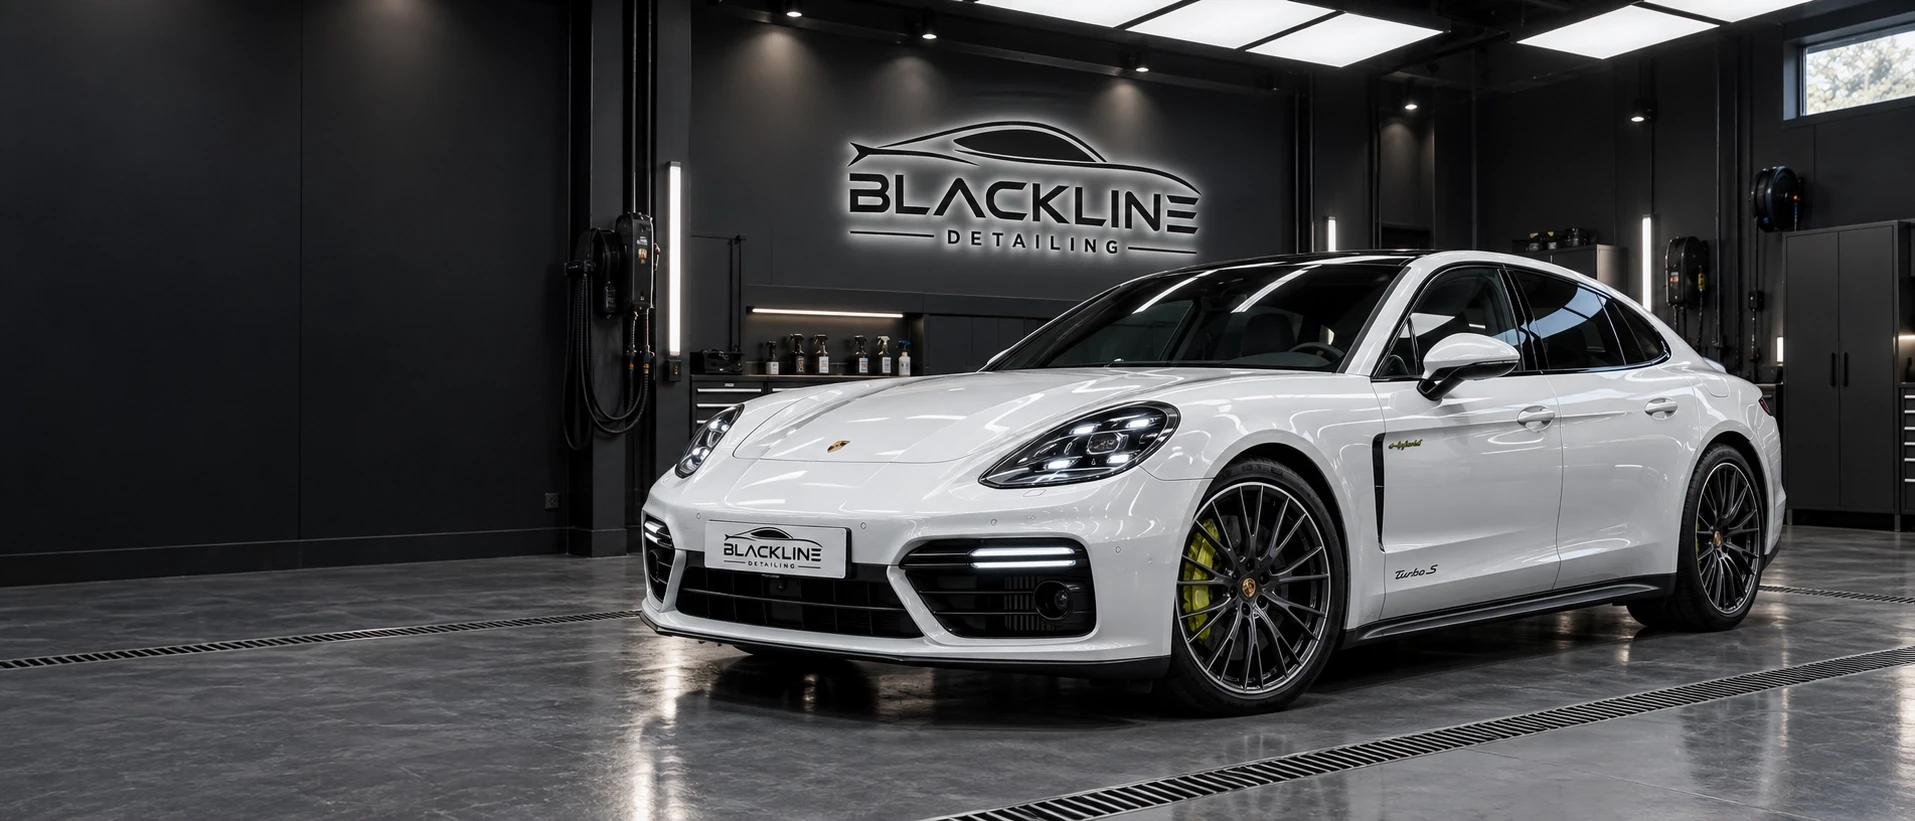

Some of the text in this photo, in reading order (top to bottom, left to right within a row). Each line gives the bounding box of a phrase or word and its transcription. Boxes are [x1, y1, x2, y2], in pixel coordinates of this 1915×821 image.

[849, 173, 1199, 235] BLACKLINE
[947, 230, 1118, 254] DETAILING
[724, 543, 821, 562] BLACKLINE
[748, 561, 795, 569] DETAILING
[1395, 564, 1438, 580] Turbo S
